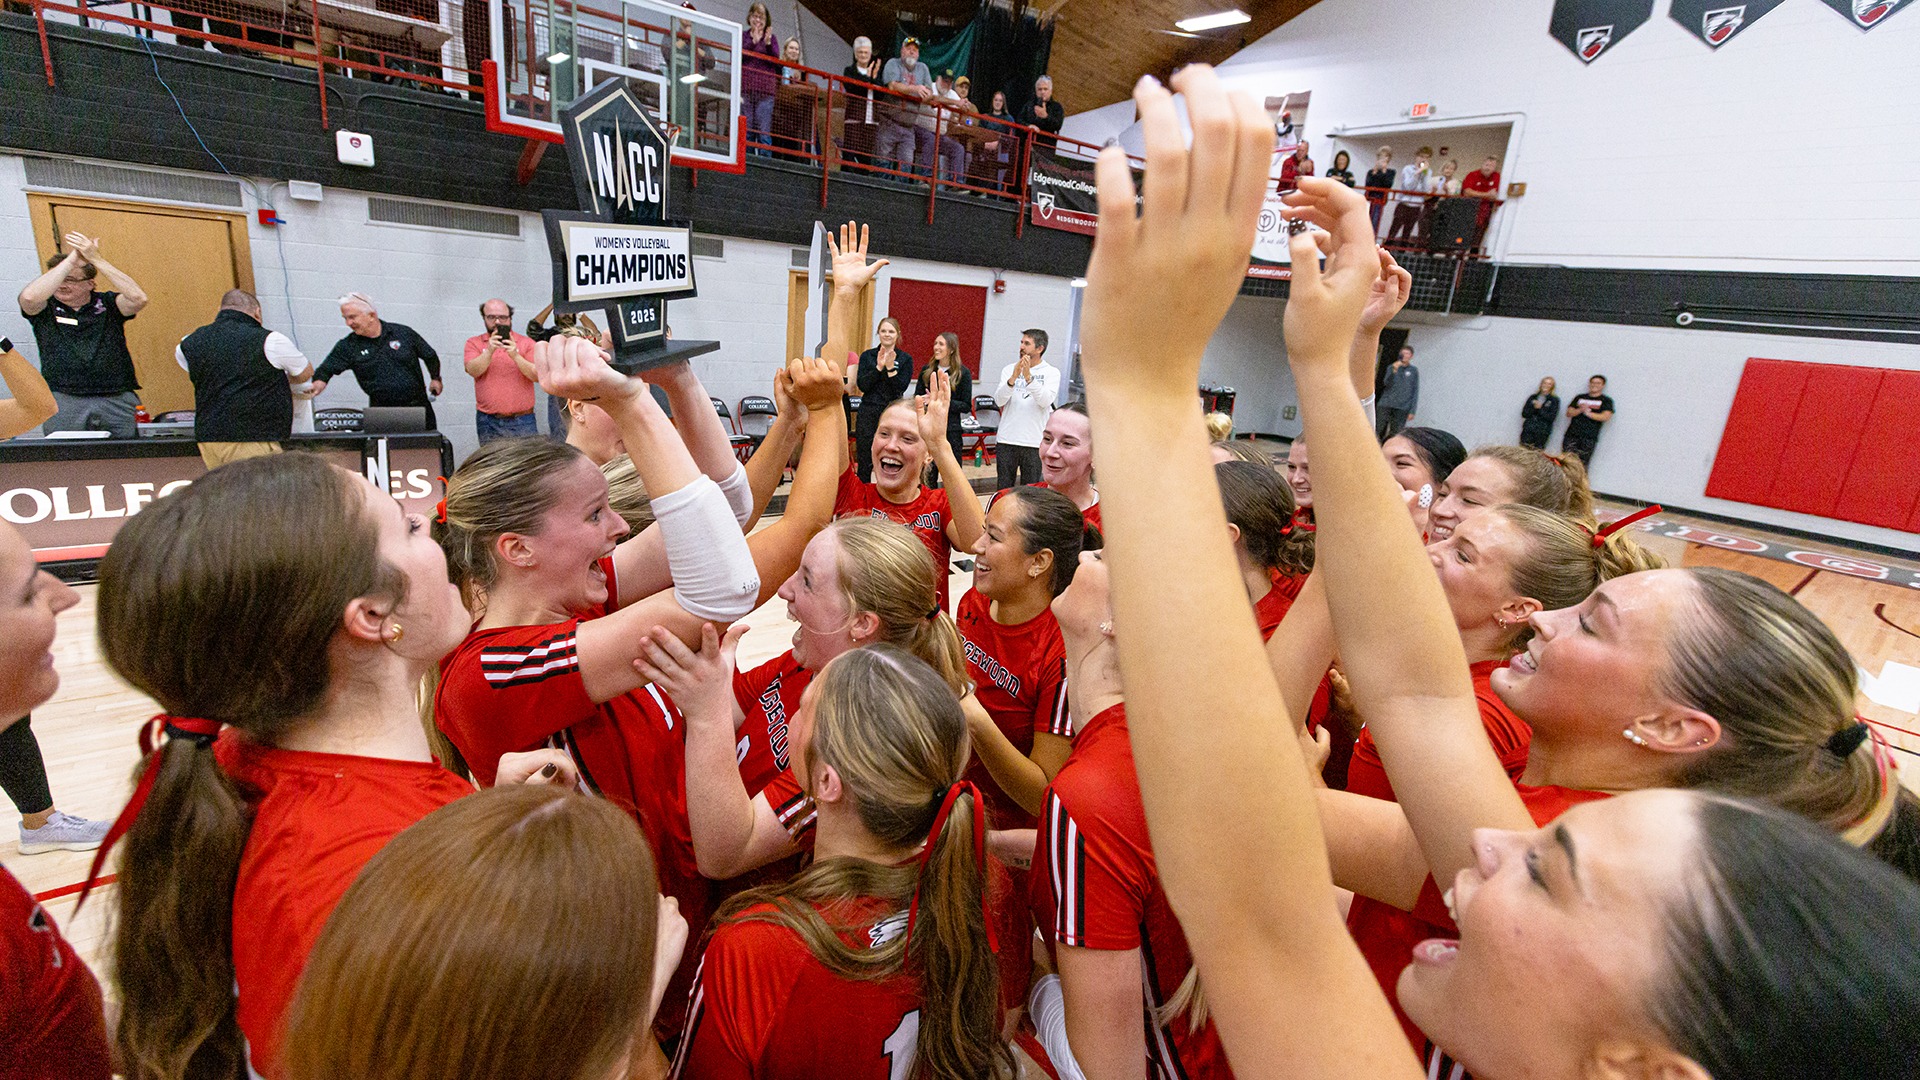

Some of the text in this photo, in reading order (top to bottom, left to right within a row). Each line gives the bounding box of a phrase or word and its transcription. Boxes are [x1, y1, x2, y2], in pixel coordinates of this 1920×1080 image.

[593, 115, 660, 211] NACC
[594, 236, 670, 250] WOMEN'S VOLLEYBALL
[576, 253, 687, 286] CHAMPIONS
[630, 308, 656, 324] 2025
